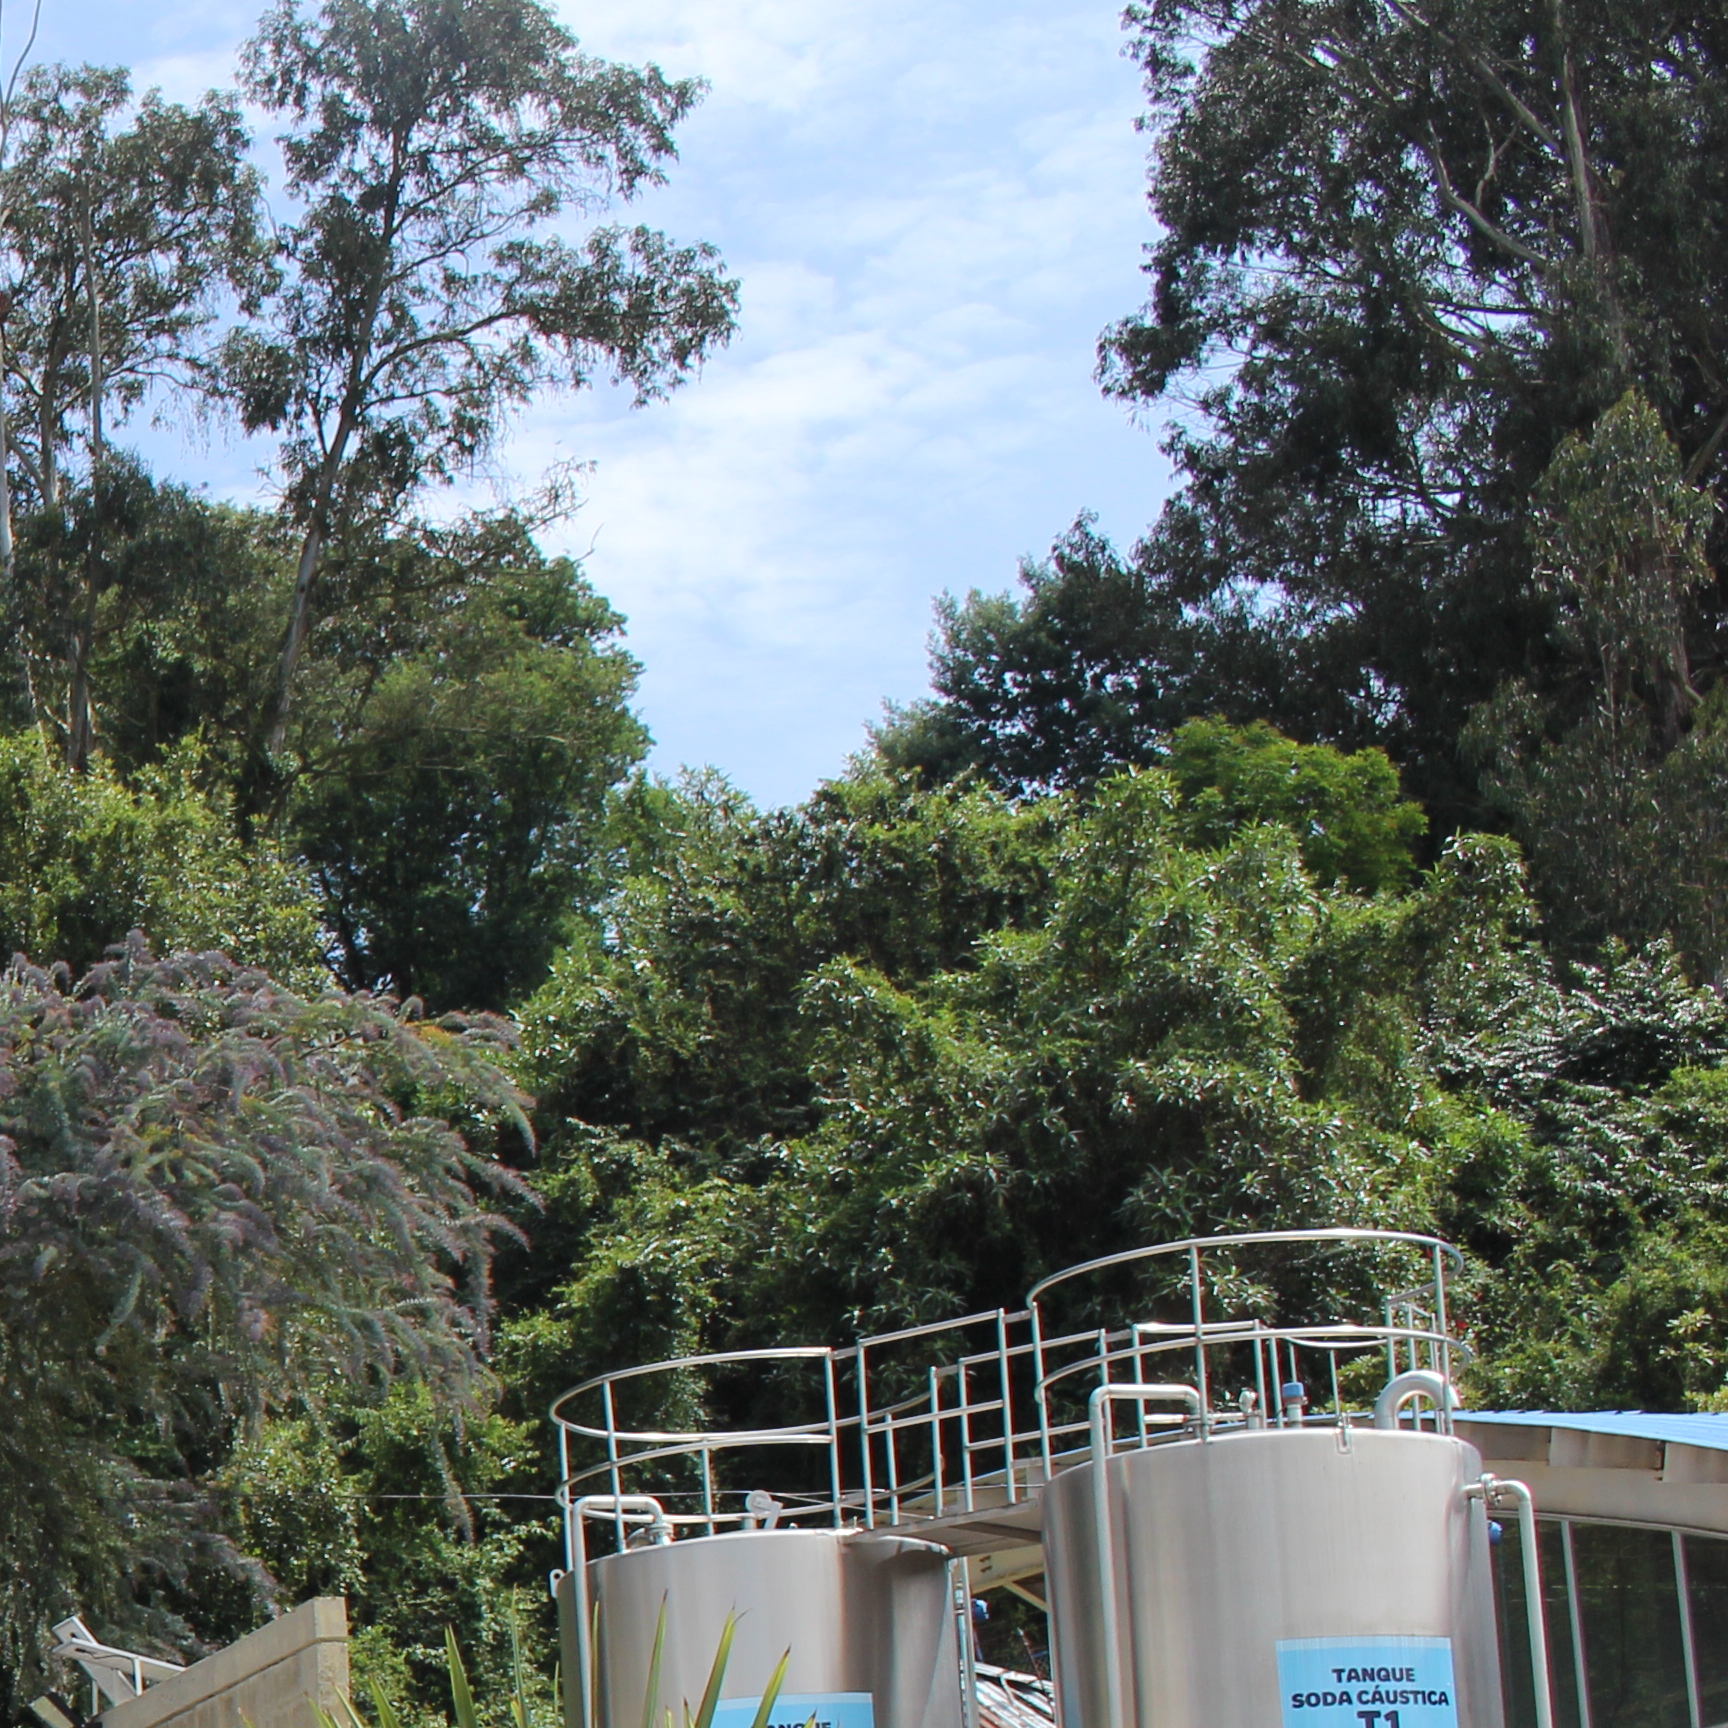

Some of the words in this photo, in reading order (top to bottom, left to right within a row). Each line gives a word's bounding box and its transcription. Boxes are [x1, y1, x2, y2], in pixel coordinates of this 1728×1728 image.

[1331, 1667, 1415, 1683] TANQUE
[1291, 1690, 1352, 1708] SODA
[1356, 1685, 1449, 1706] CÁUSTICA
